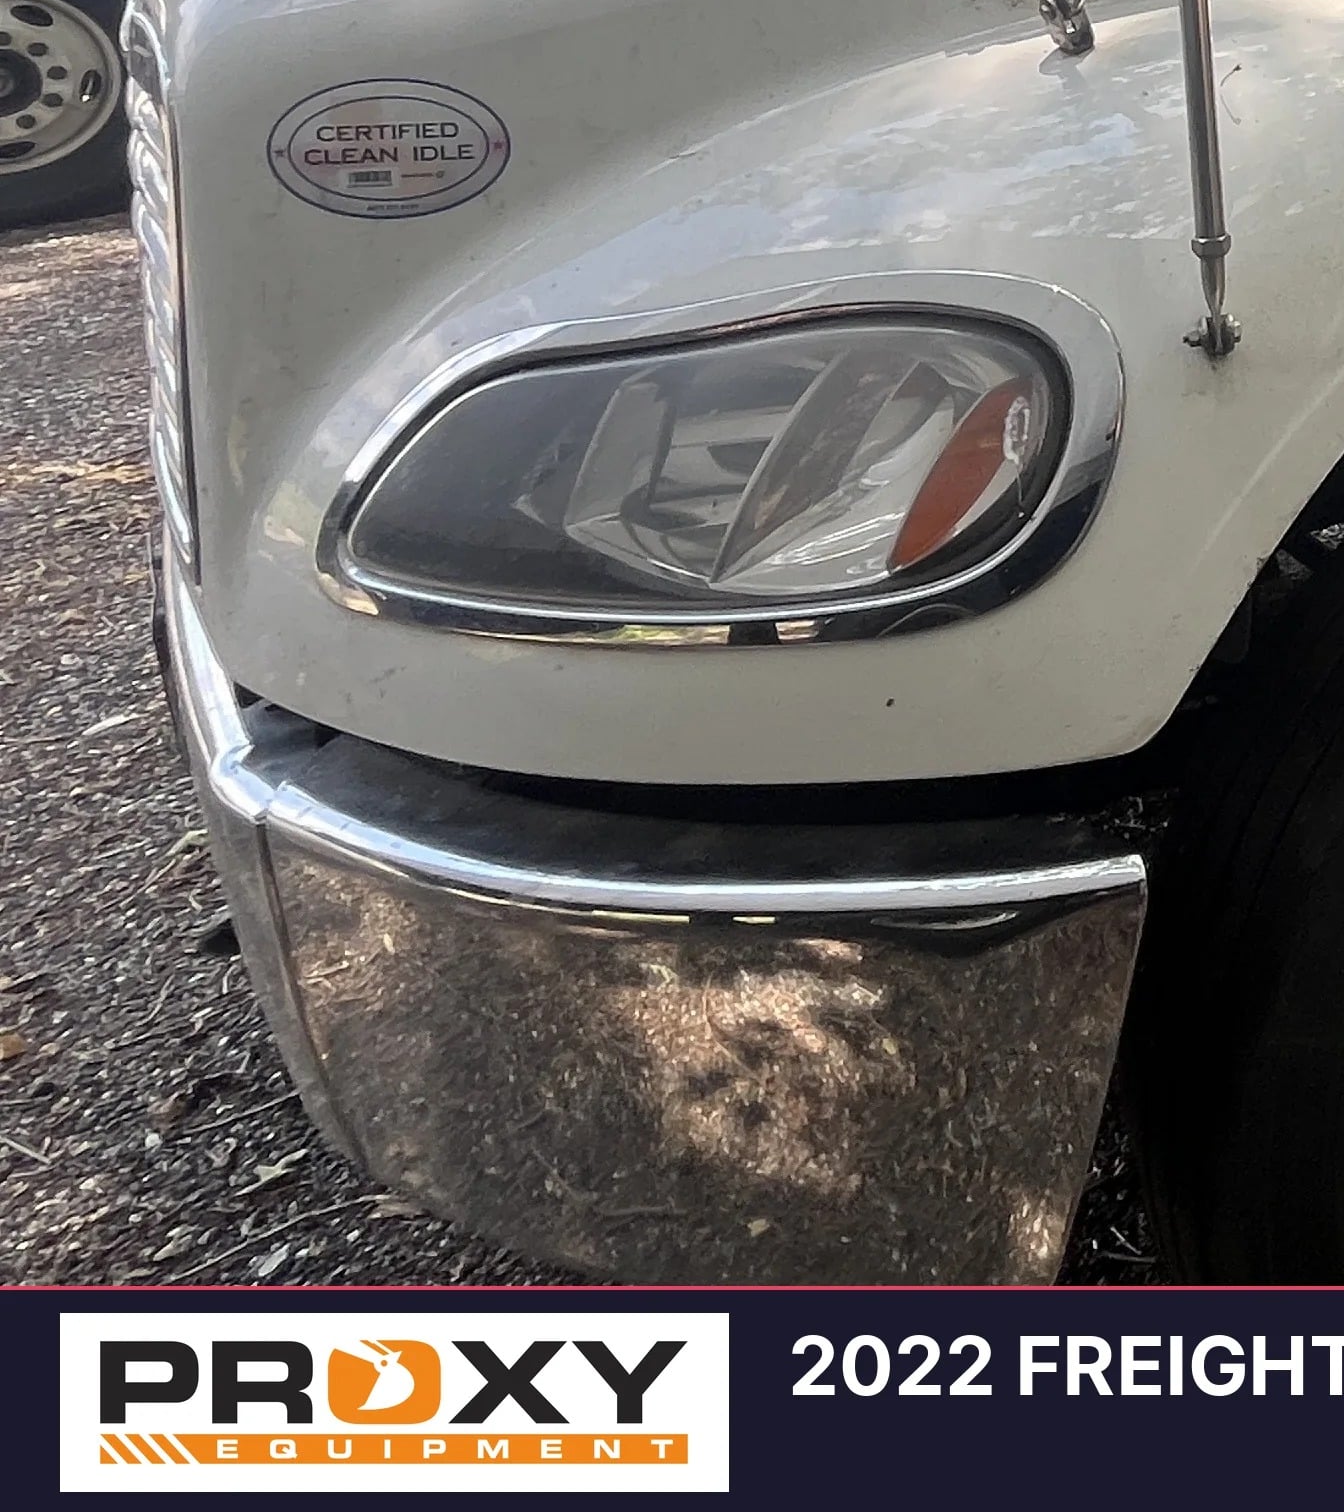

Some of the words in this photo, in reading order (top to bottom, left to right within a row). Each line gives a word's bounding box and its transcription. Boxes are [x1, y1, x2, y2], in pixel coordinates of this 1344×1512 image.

[316, 121, 460, 143] CERTIFIED
[303, 146, 400, 166] CLEAN
[412, 143, 476, 162] IDLE
